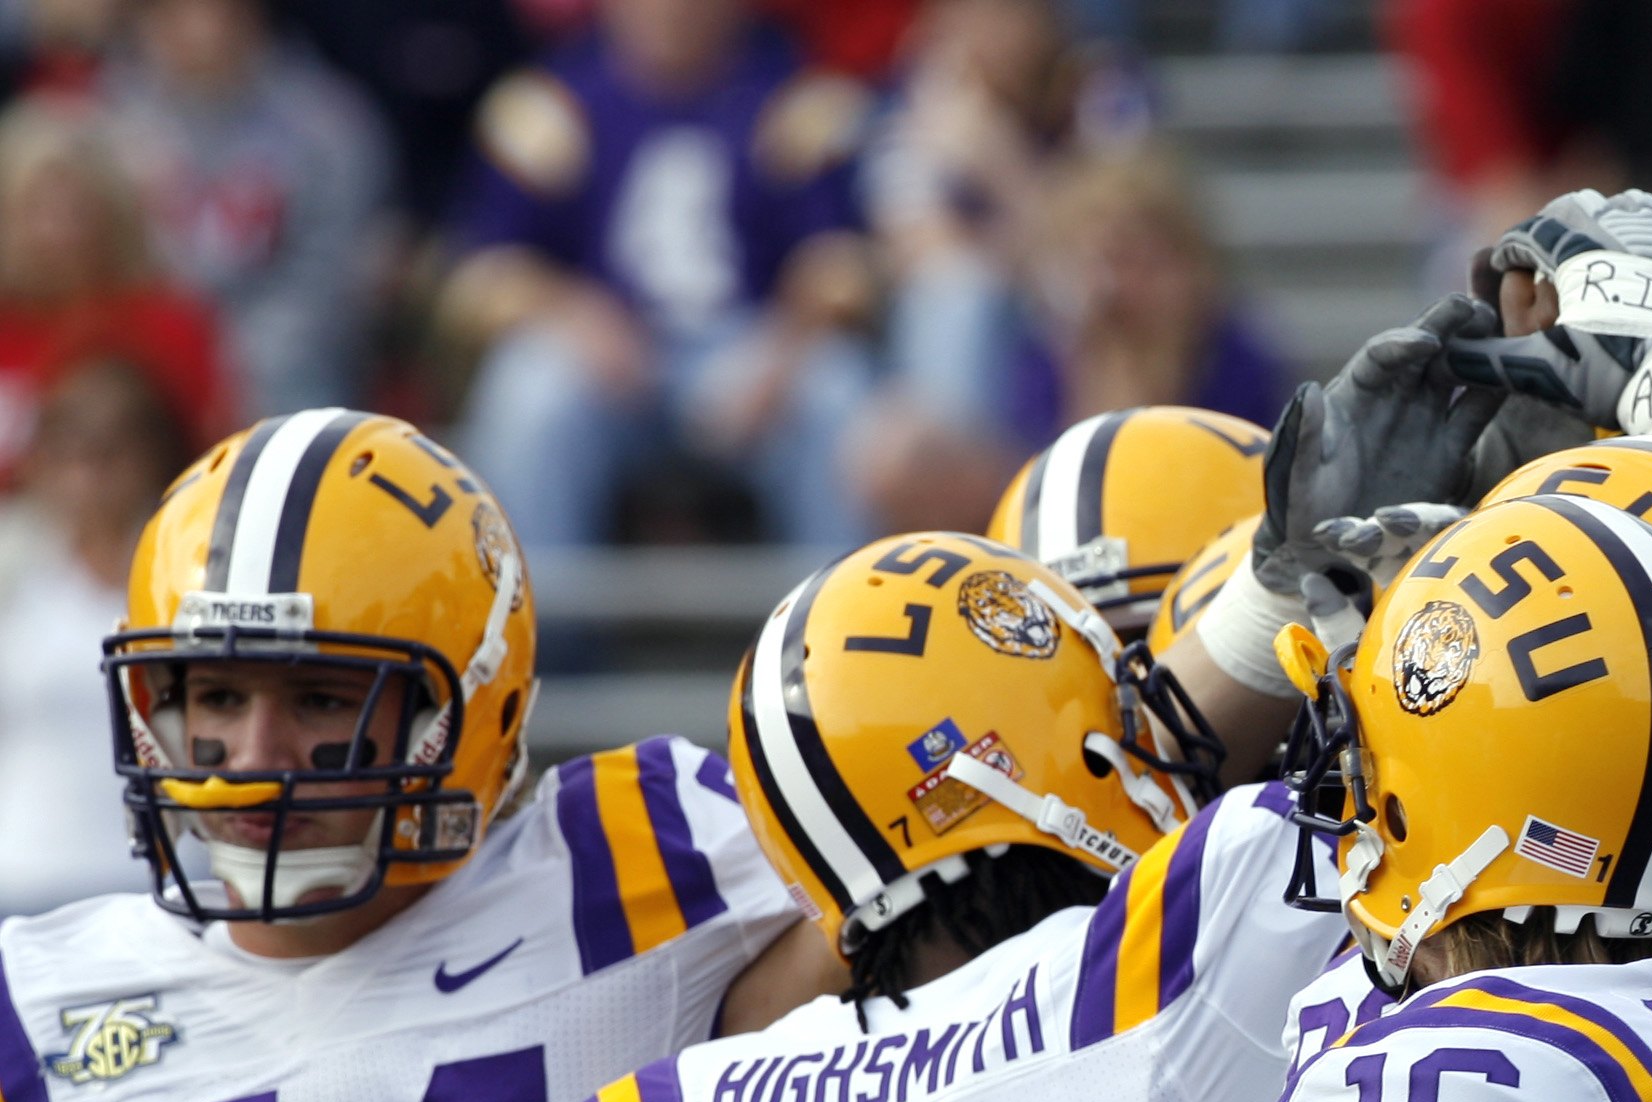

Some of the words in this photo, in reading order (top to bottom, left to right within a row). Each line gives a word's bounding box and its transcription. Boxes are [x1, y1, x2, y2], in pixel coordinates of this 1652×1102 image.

[211, 602, 276, 622] TIGERS
[843, 536, 1022, 658] LS
[1409, 520, 1609, 702] LSU
[888, 814, 913, 848] 7
[87, 1023, 141, 1078] SEC
